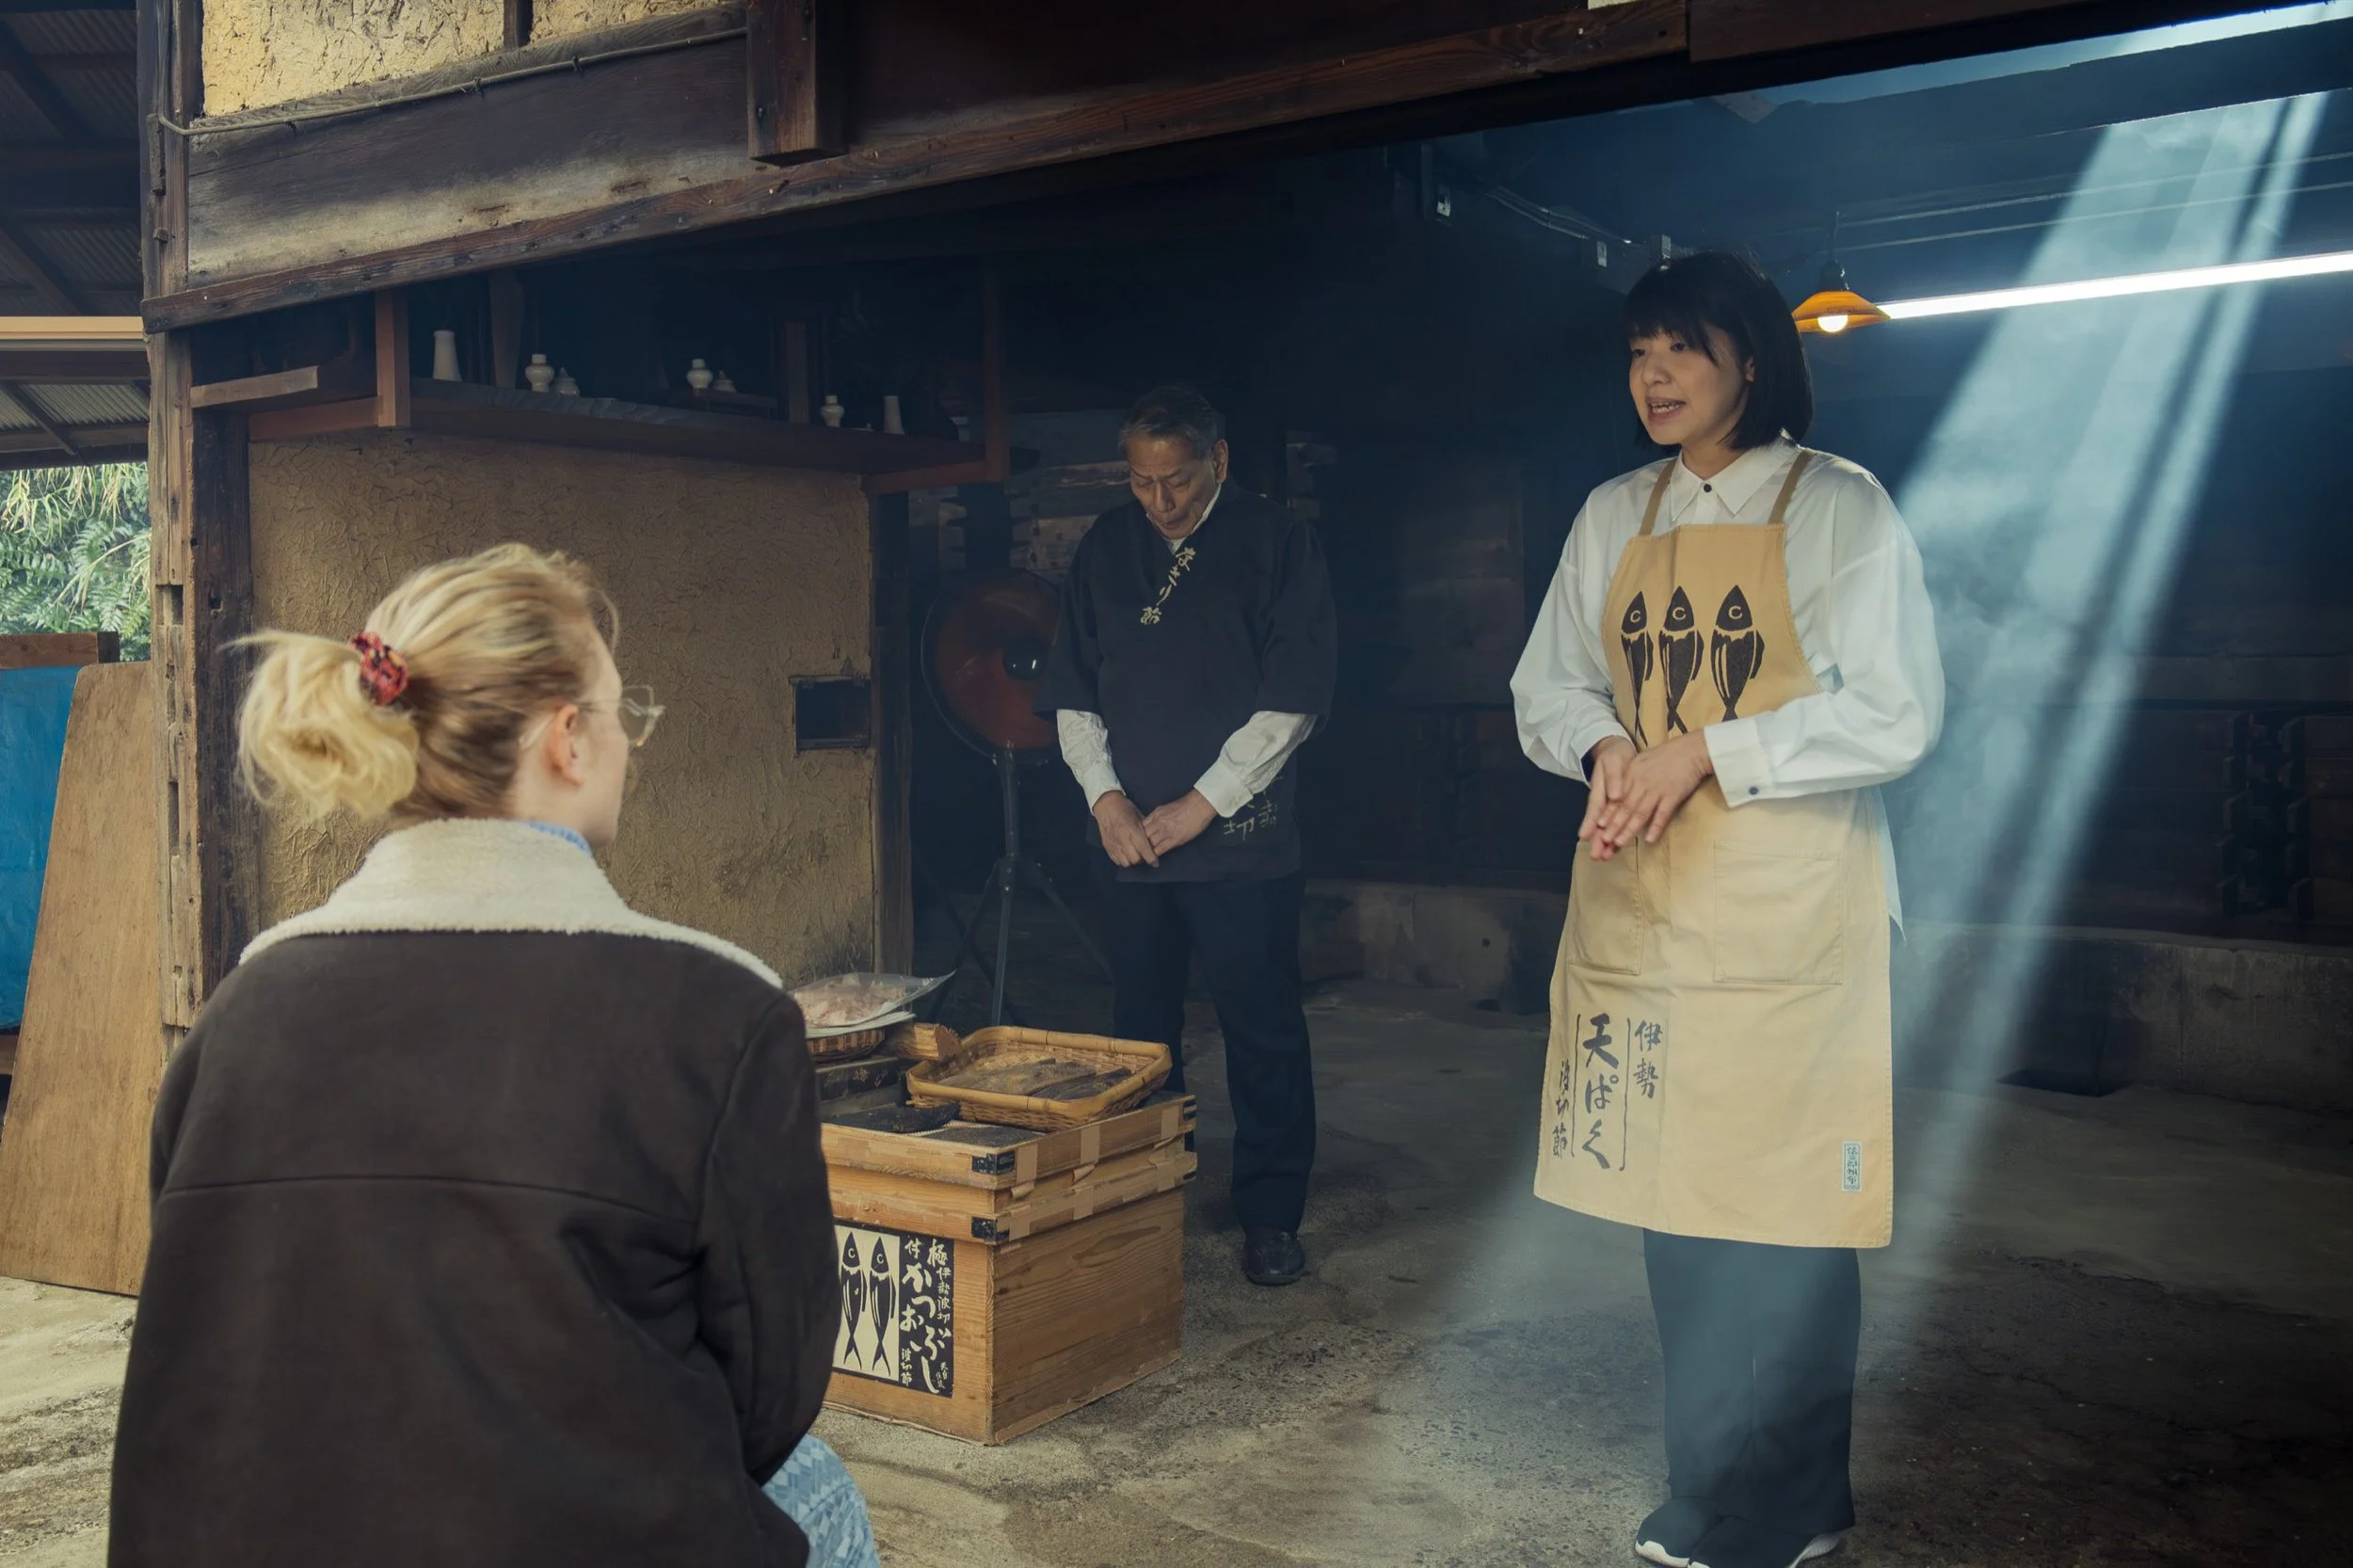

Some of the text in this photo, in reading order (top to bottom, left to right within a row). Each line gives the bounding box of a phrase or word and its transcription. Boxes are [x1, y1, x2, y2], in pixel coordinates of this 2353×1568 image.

[1582, 1013, 1619, 1169] 天ぱく
[1633, 1019, 1663, 1099] 伊勢
